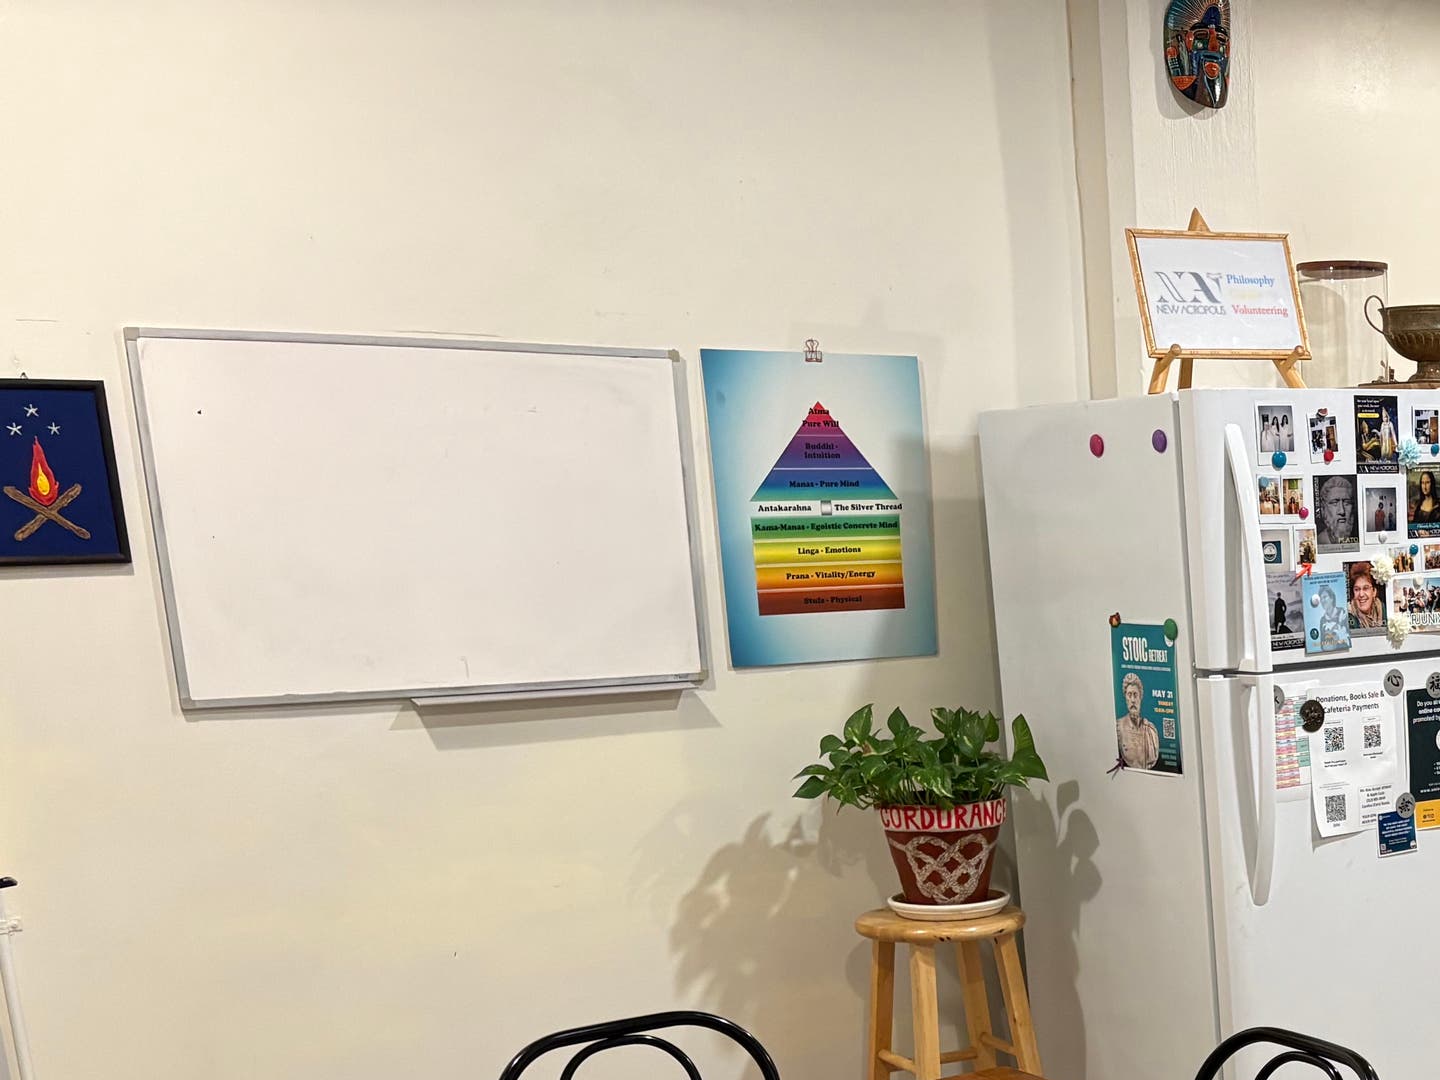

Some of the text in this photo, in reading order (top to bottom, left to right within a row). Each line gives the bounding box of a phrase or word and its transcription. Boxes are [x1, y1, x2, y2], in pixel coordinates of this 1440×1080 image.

[1226, 273, 1275, 288] Philosophy
[1156, 304, 1227, 316] NEW ACROPOLIS
[1231, 304, 1289, 318] Volunteering
[802, 420, 839, 428] Pure Will
[805, 443, 834, 451] Buddhi
[804, 451, 840, 459] Intuition
[789, 480, 814, 488] Manas
[820, 480, 839, 488] Pure
[840, 479, 860, 487] Mind
[850, 503, 874, 511] Silver
[875, 503, 903, 511] Thread
[811, 522, 842, 531] Egoistic
[843, 521, 877, 530] Concrete
[879, 521, 898, 529] Mind
[798, 548, 819, 556] Linga
[825, 546, 861, 554] Emotions
[815, 570, 876, 580] Vitality/Energy
[830, 595, 863, 604] Physical
[1122, 636, 1148, 662] STOIC
[1152, 689, 1166, 698] MAY
[1315, 695, 1348, 703] Donations,
[1349, 692, 1367, 701] Books
[1368, 691, 1379, 699] Sale
[1324, 703, 1379, 713] Cafeteria Payments
